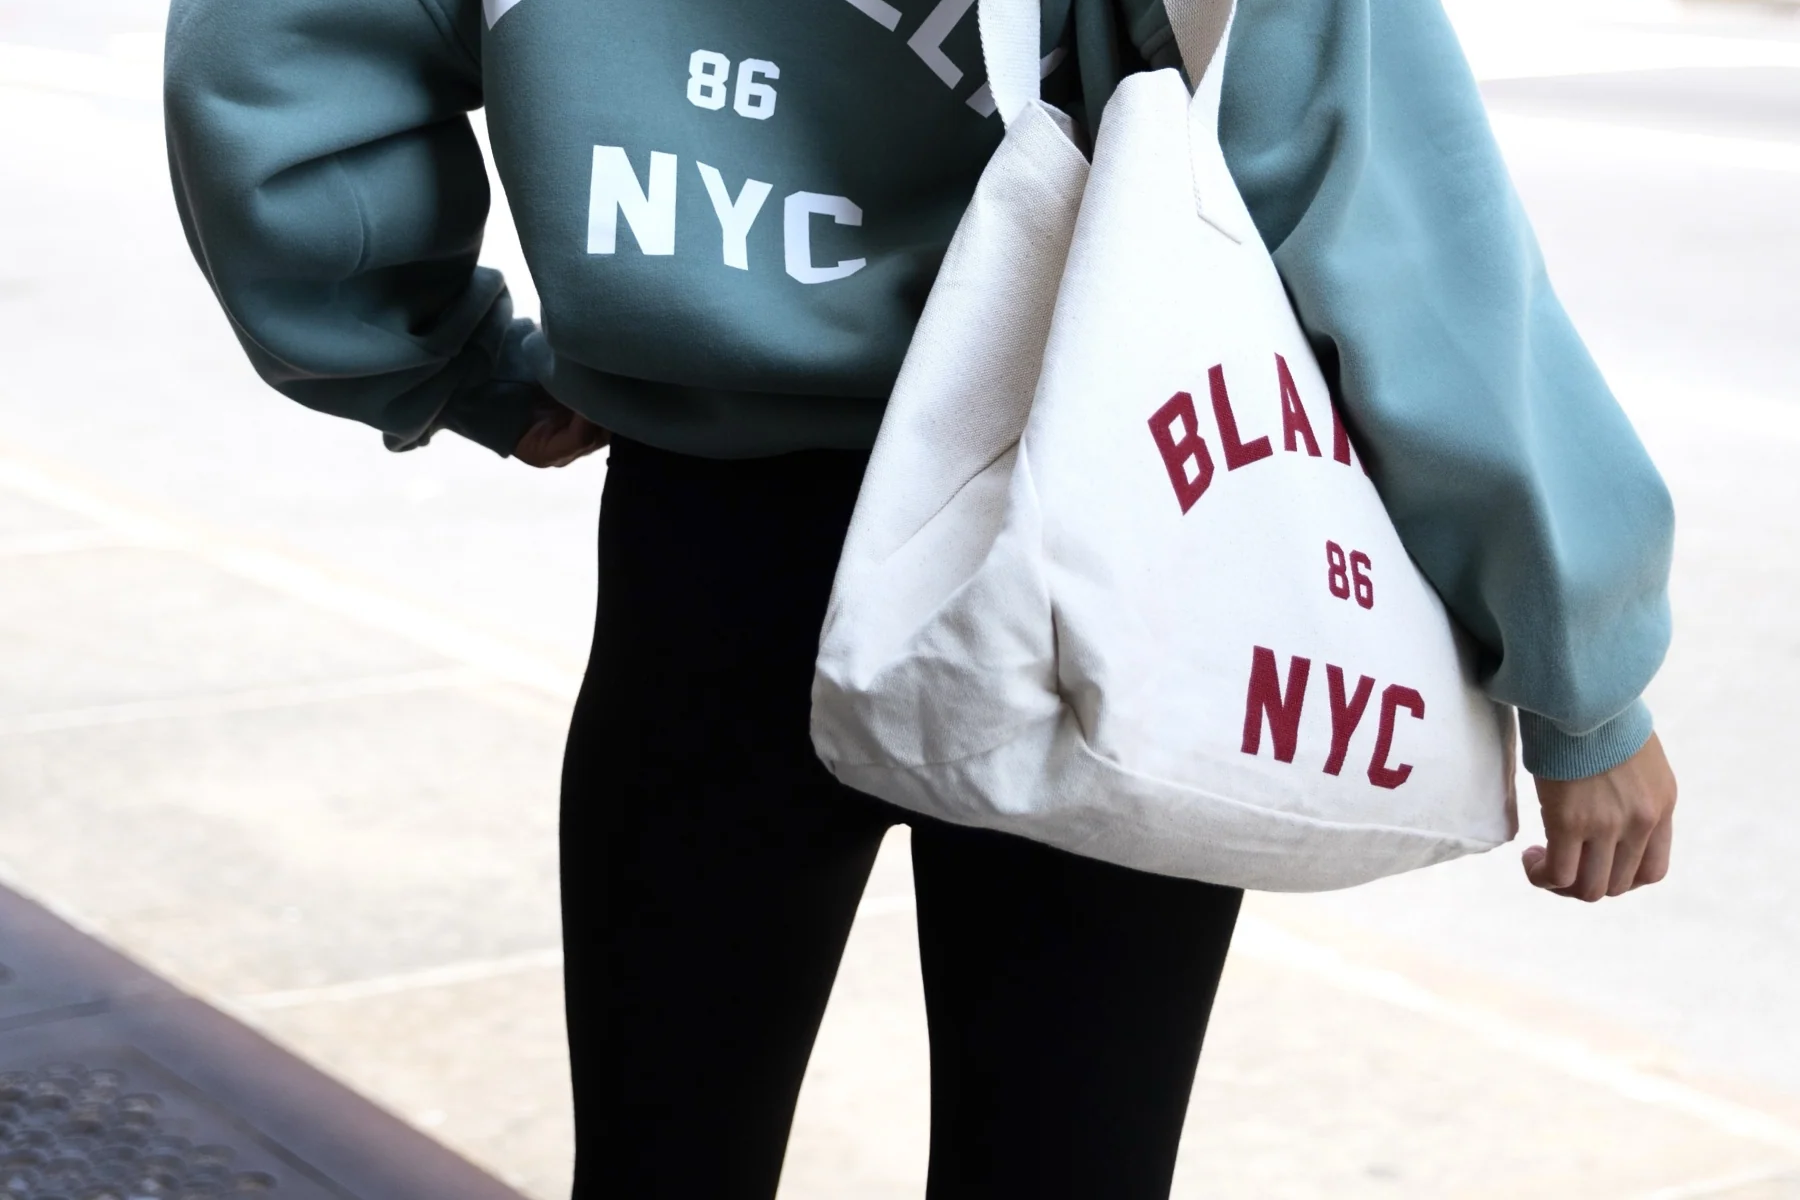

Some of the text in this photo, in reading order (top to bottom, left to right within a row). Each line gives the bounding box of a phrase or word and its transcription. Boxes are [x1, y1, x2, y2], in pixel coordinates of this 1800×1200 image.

[686, 48, 781, 121] 86
[586, 144, 867, 285] NYC
[1326, 539, 1375, 611] 86
[1240, 645, 1426, 790] NYC
